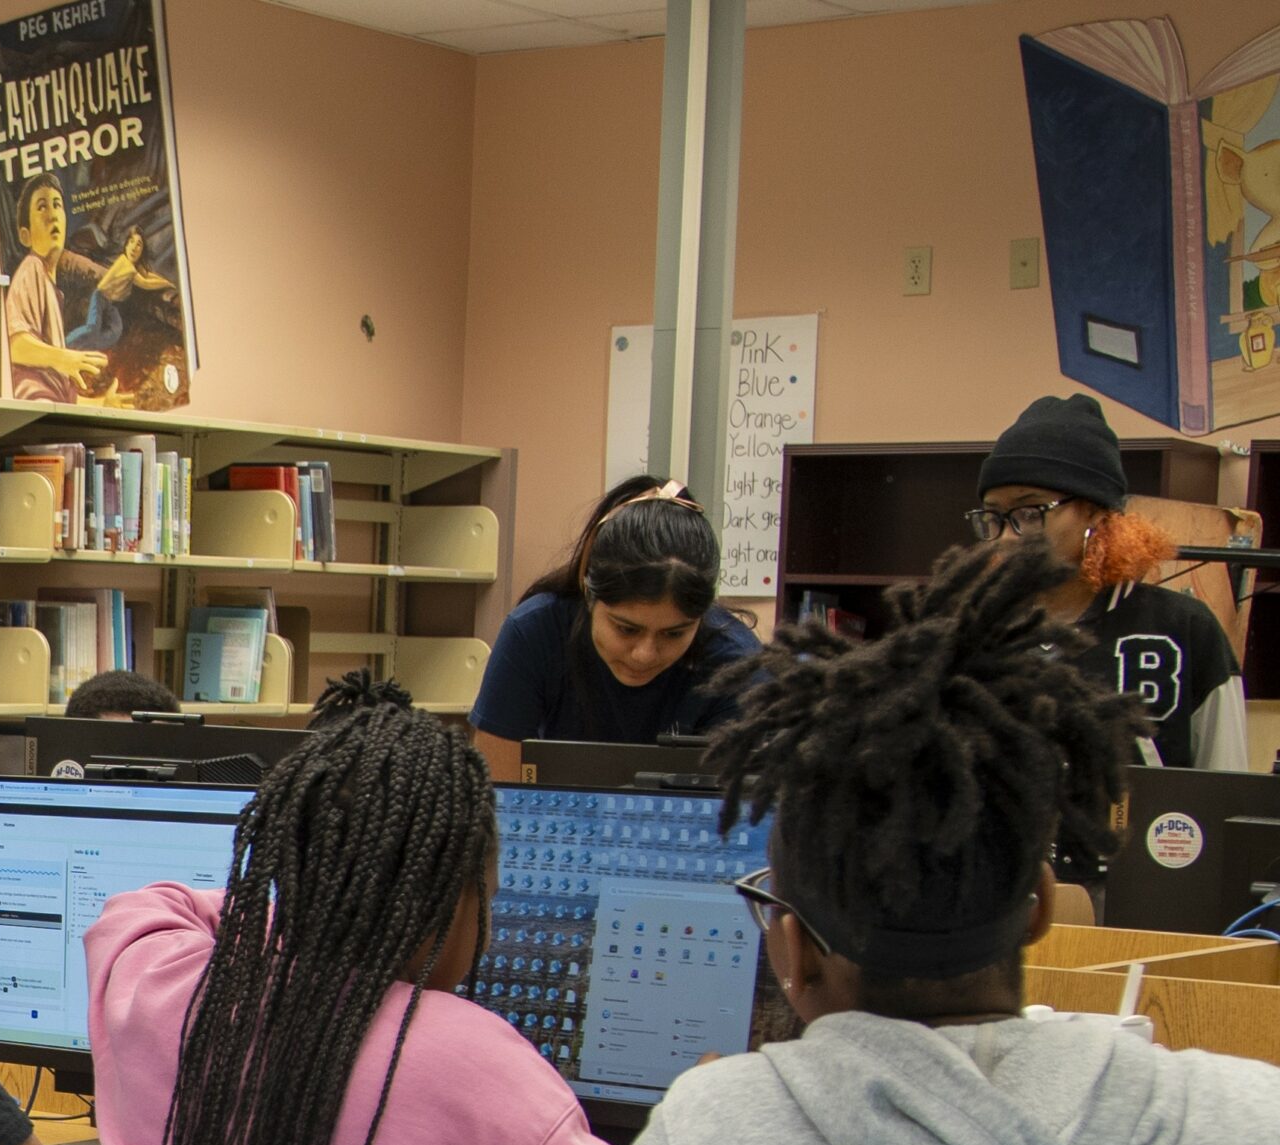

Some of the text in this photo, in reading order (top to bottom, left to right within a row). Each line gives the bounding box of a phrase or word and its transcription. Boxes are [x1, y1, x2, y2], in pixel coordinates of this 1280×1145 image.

[20, 0, 107, 41] PEG KEHRET
[736, 368, 785, 397] Blue
[730, 399, 798, 437] Orange
[726, 464, 782, 500] Light gre
[762, 511, 782, 531] gre
[756, 548, 777, 563] ora
[720, 568, 748, 587] Red
[190, 638, 202, 685] READ
[1115, 634, 1182, 722] B
[1155, 819, 1195, 838] M-DCPS
